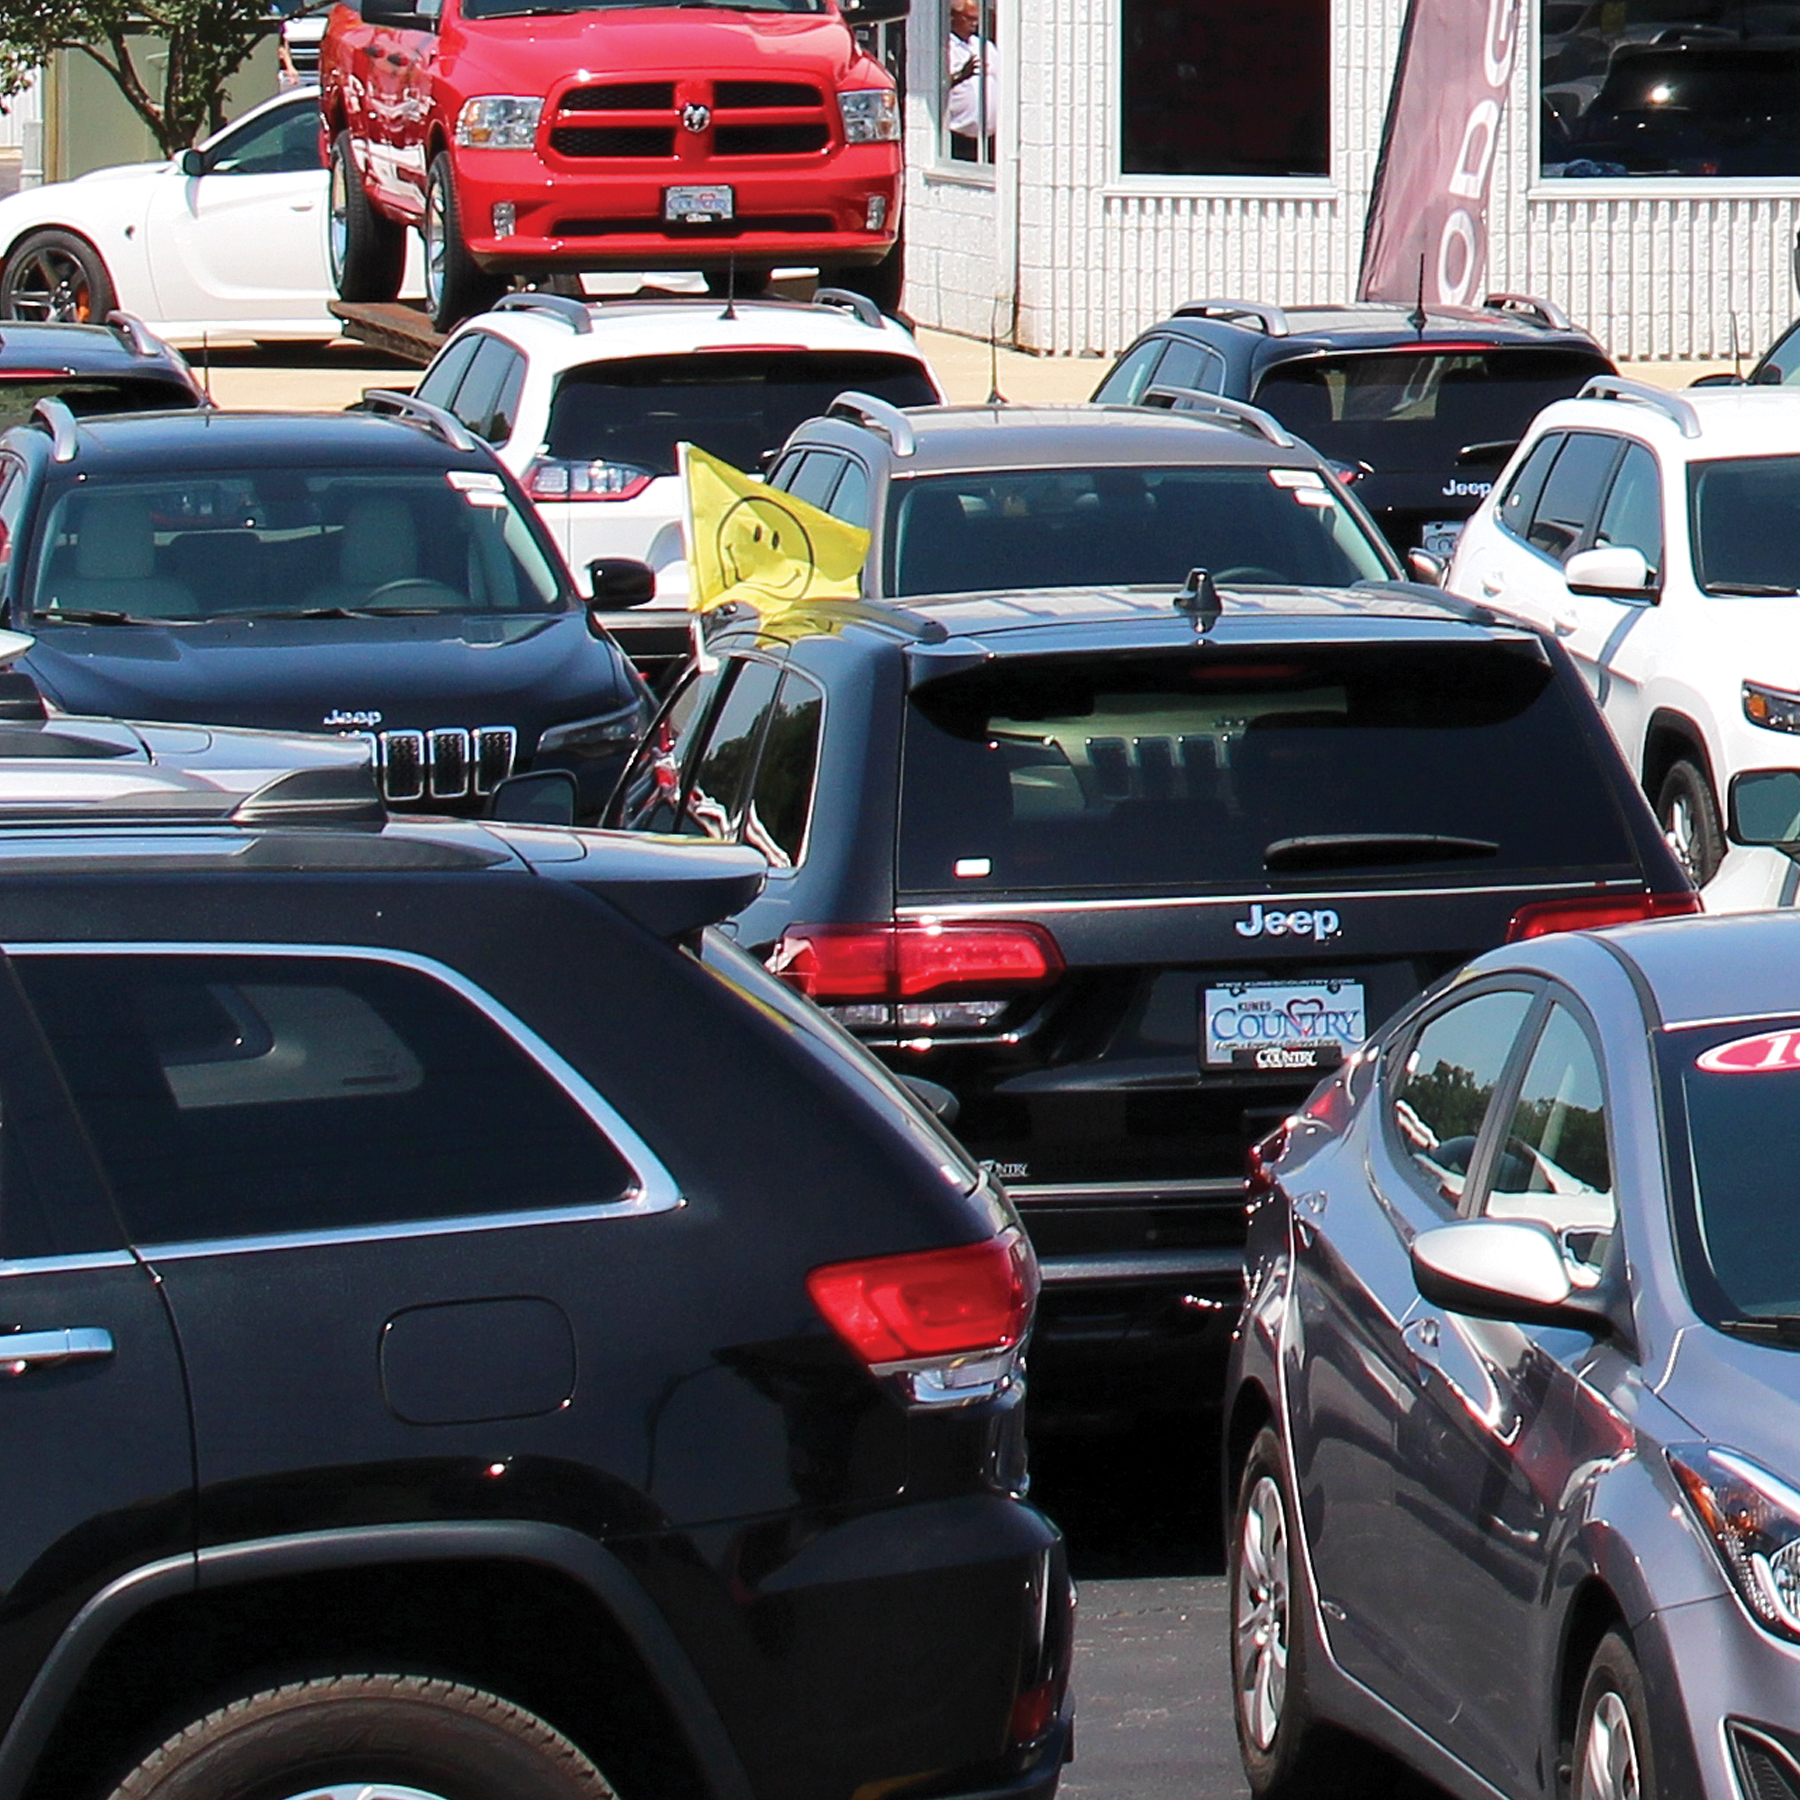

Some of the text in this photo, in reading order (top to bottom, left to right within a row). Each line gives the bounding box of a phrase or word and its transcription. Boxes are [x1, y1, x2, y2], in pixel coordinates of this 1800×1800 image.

[1442, 479, 1493, 499] Jeep
[323, 709, 382, 727] Jeep
[1235, 904, 1340, 941] Jeep
[1211, 1007, 1366, 1044] COUNTRY
